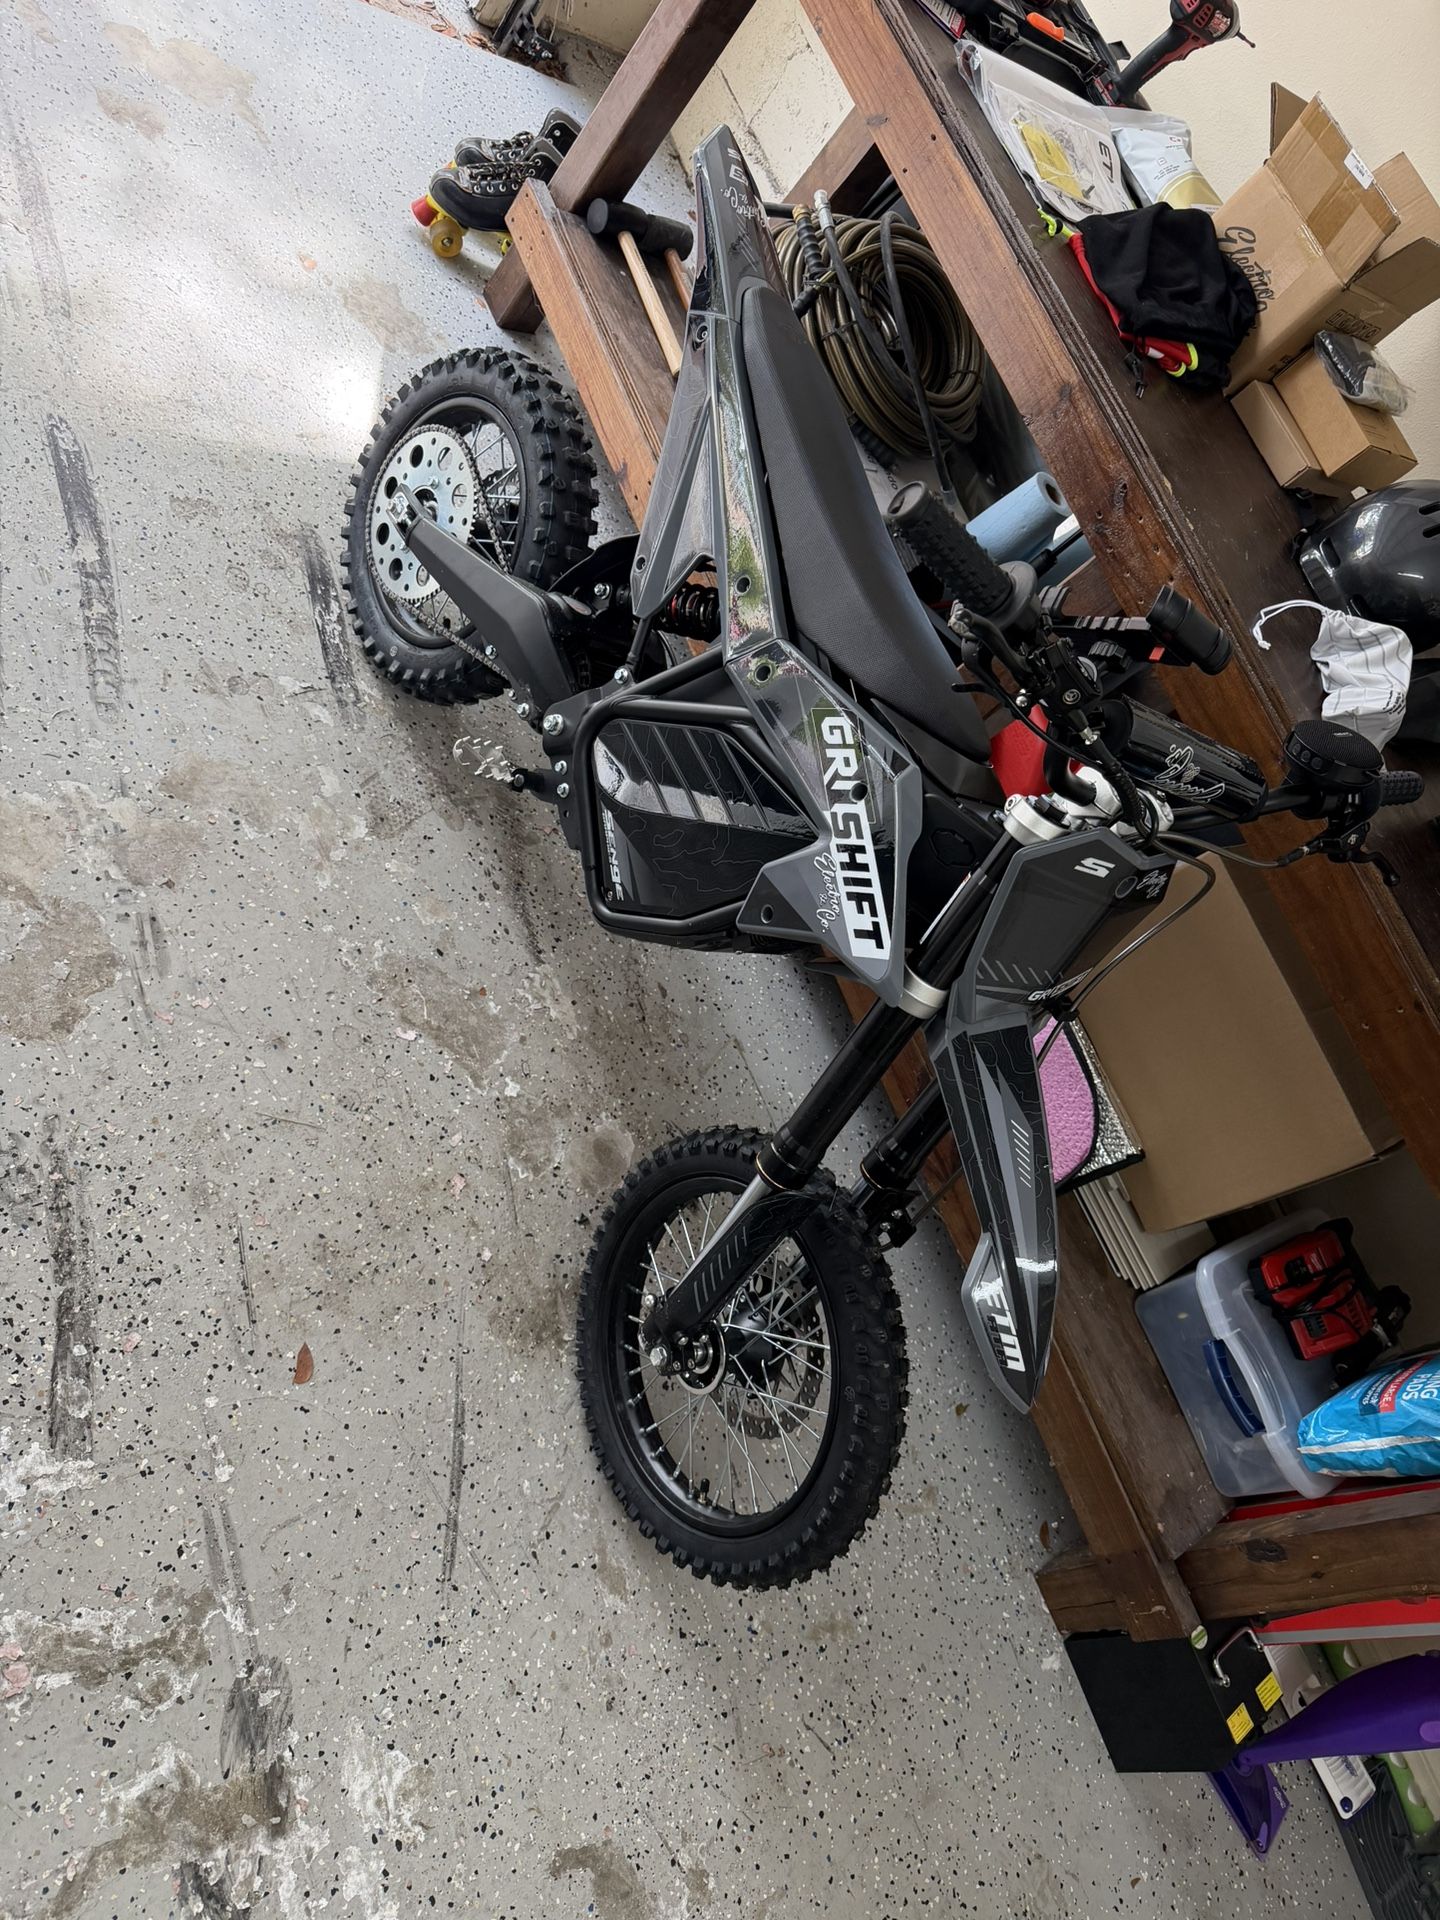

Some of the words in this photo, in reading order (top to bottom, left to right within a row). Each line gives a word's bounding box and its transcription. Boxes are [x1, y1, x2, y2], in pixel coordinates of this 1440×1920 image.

[813, 852, 841, 916] Electro
[819, 893, 829, 905] &
[816, 908, 836, 933] Co.
[1402, 1373, 1432, 1400] PADS
